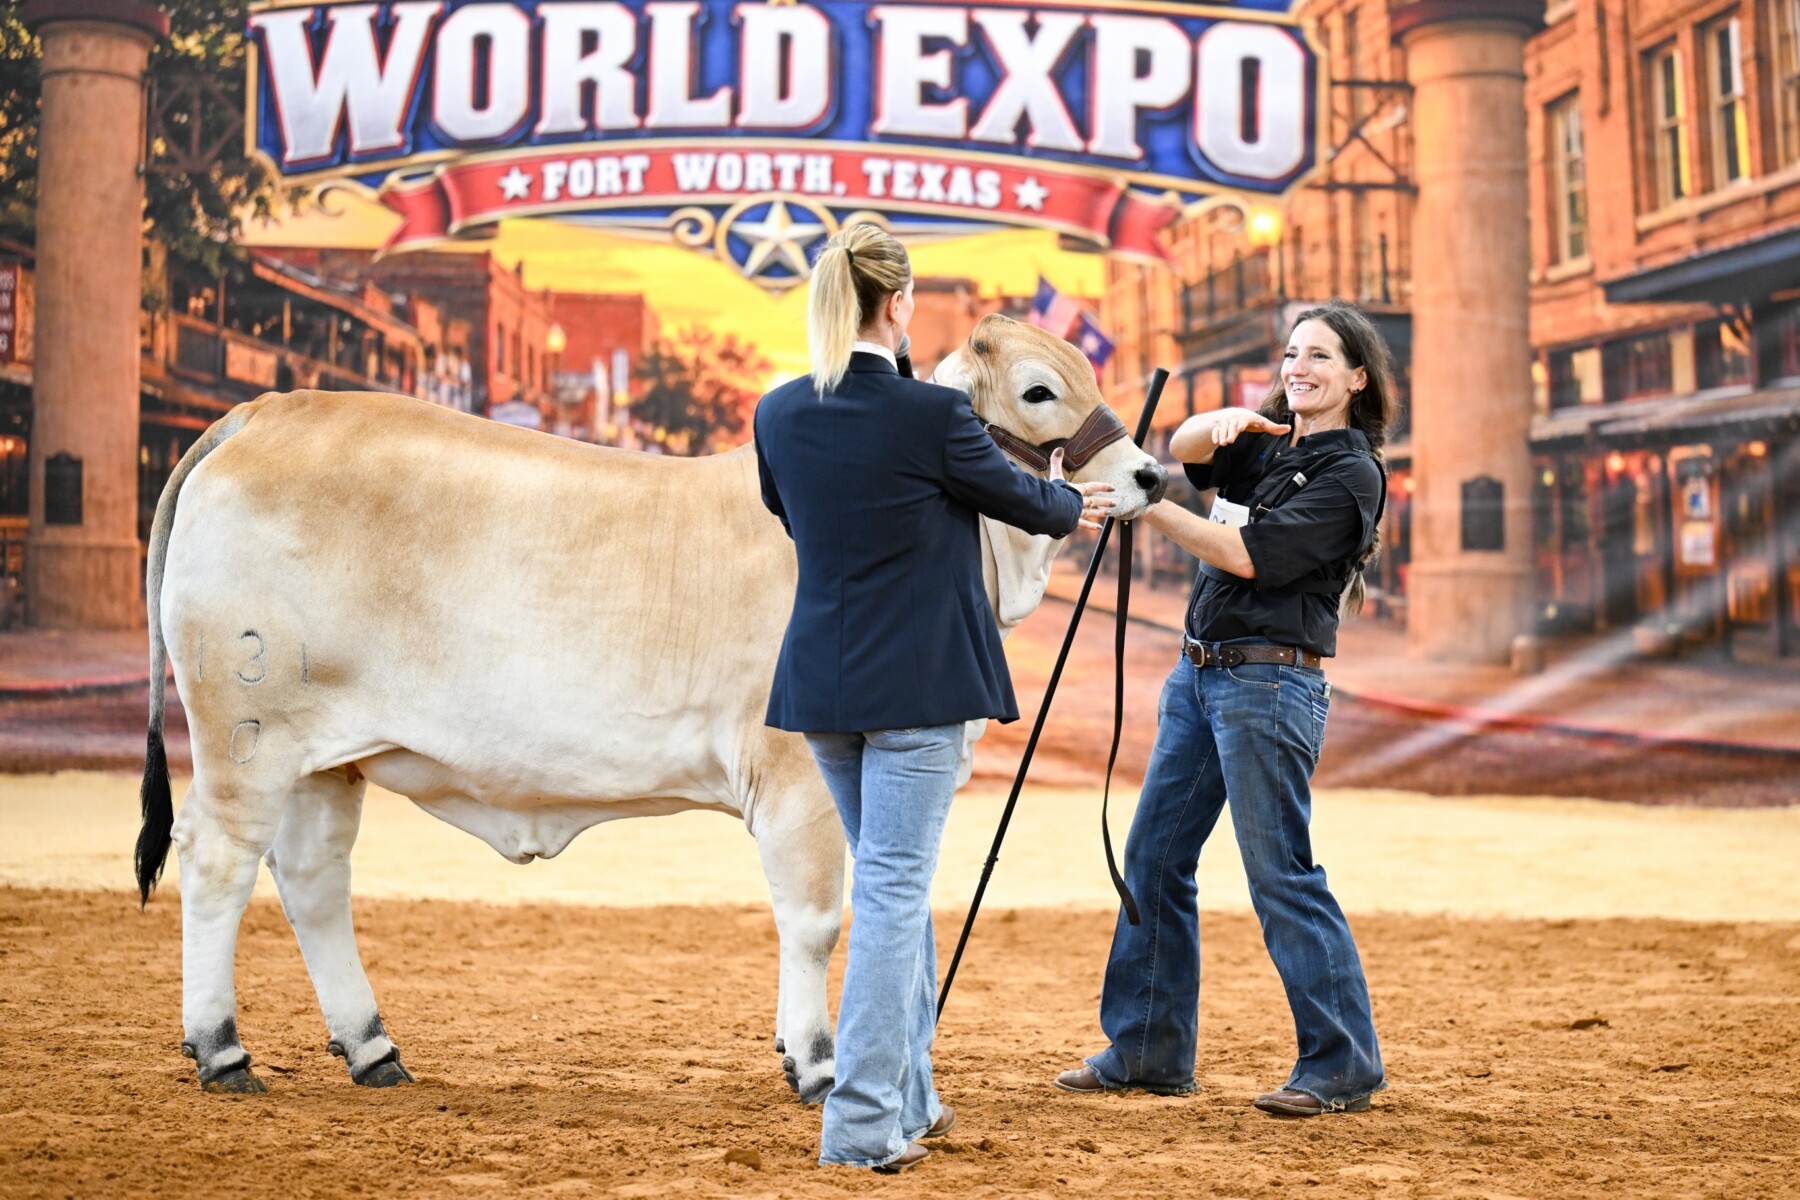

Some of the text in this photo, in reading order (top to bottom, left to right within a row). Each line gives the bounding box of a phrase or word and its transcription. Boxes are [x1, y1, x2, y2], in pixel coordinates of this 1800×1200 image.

[249, 1, 1305, 180] WORLD EXPO
[541, 152, 1001, 208] FORT WORTH, TEXAS
